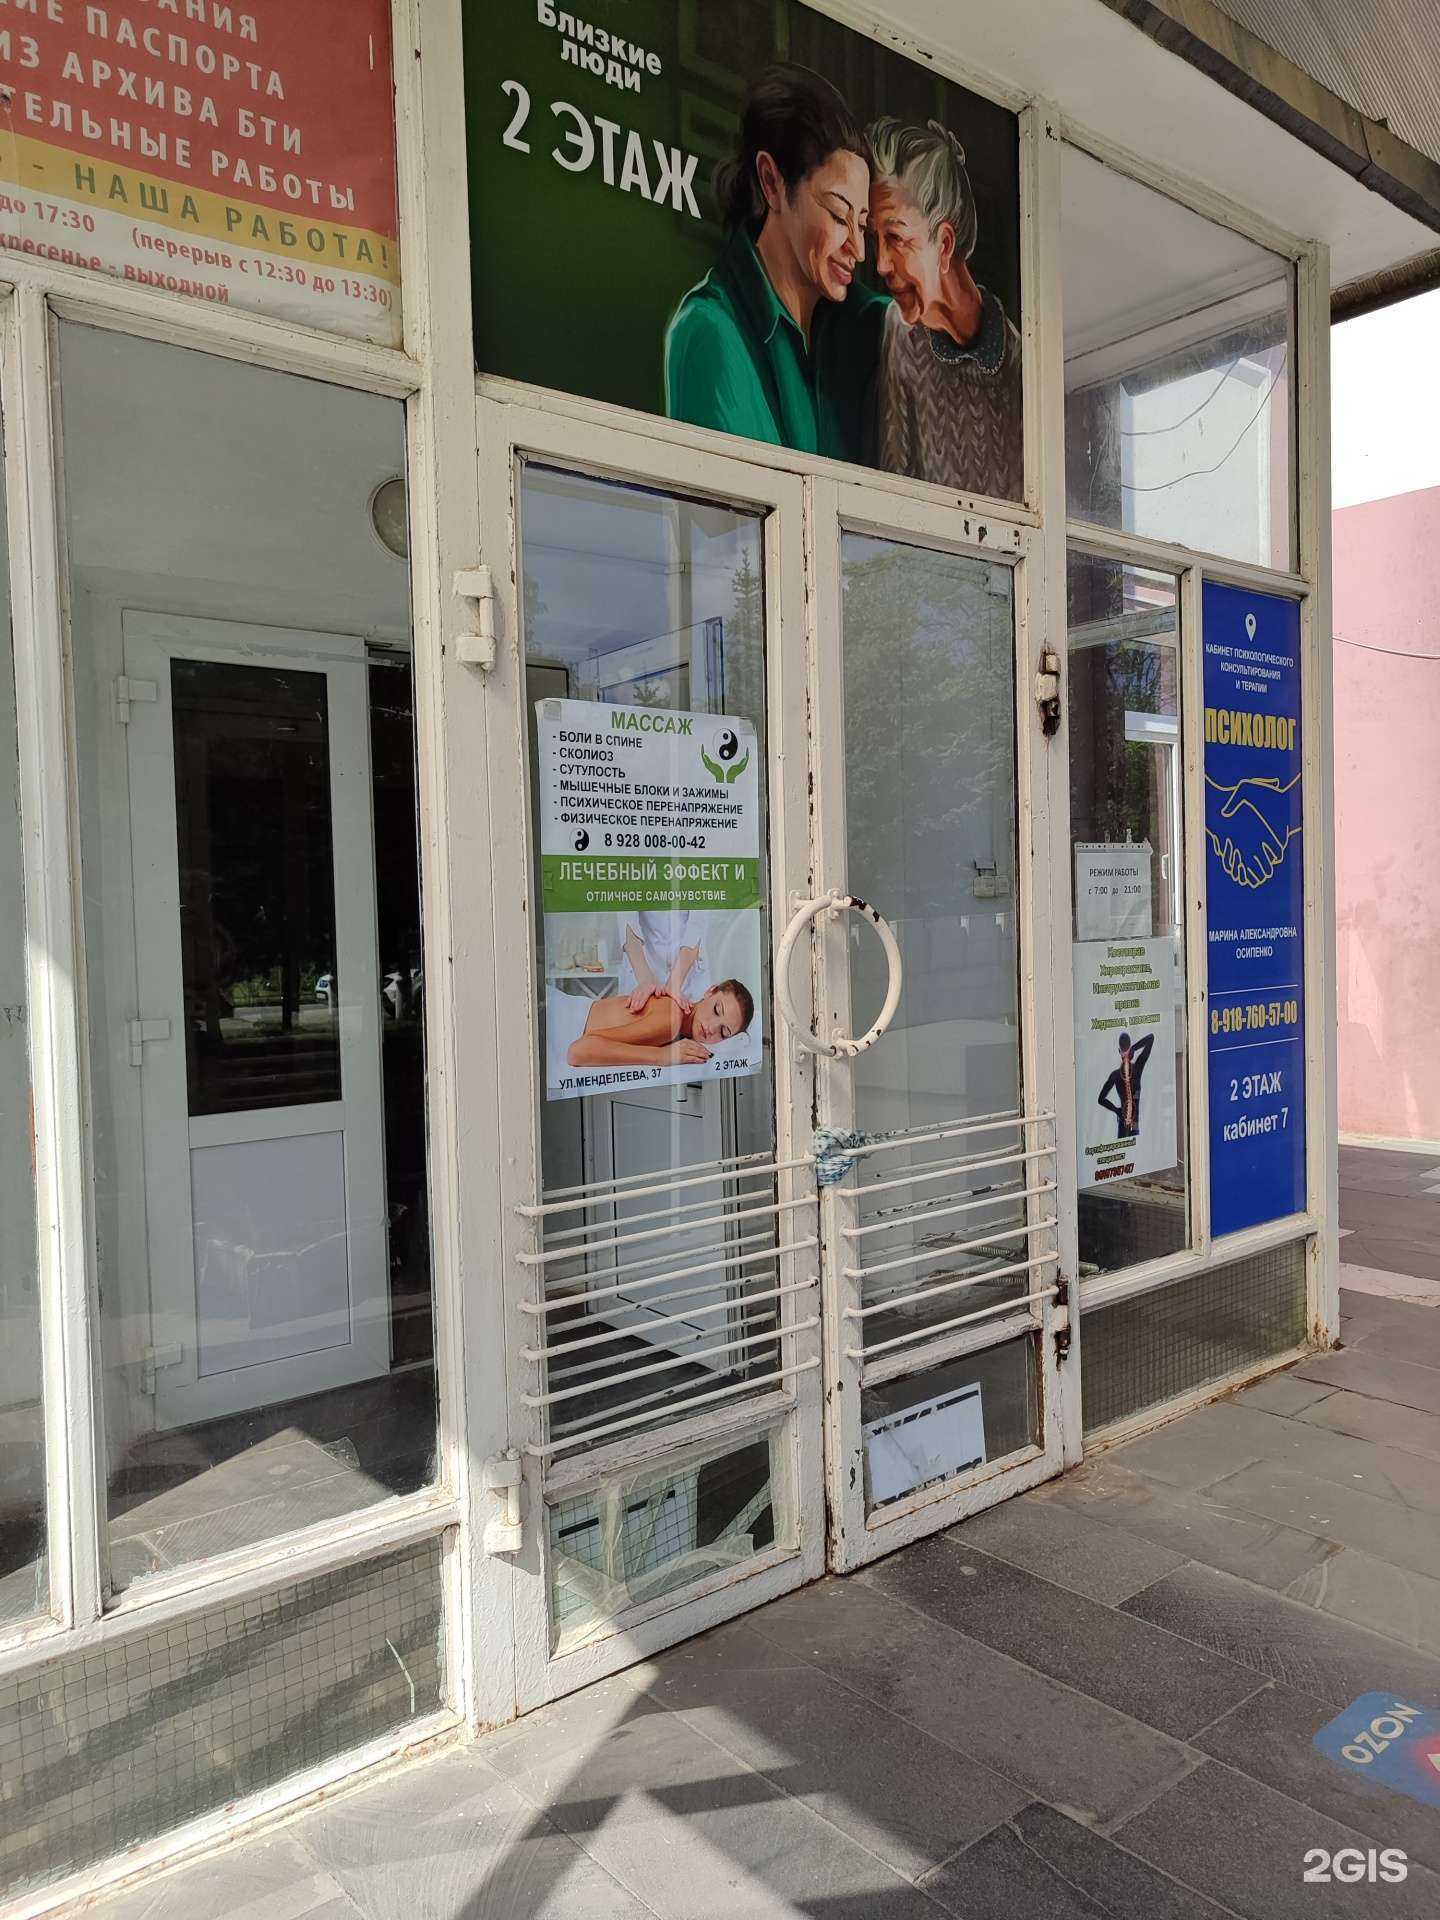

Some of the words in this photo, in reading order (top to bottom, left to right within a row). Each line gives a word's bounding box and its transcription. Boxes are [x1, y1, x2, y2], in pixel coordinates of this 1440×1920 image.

[537, 0, 662, 75] Близкие
[87, 5, 285, 100] ПАСПОРТА
[62, 51, 218, 128] АРХИВА
[238, 107, 301, 156] БТИ
[501, 79, 531, 154] 2
[550, 101, 702, 219] ЭТАЖ
[211, 150, 355, 211] РАБОТЫ
[74, 163, 200, 224] НАША
[225, 206, 389, 270] РАБОТА!
[34, 202, 95, 232] 17:30
[132, 227, 232, 269] (перерыв
[239, 259, 248, 273] с
[254, 259, 306, 285] 12:30
[312, 275, 335, 294] до
[341, 279, 392, 312] 13:30)
[124, 264, 229, 303] выходной
[1206, 643, 1233, 657] КАБИНЕТ
[1234, 648, 1294, 668] ПСИХОЛОГИЧЕСКОГО
[1220, 661, 1281, 680] КОНСУЛЬТИРОВАНИЯ
[1236, 680, 1240, 690] И
[1242, 681, 1268, 693] ТЕРАПИИ
[611, 711, 694, 735] МАССАЖ
[1204, 707, 1297, 750] ПСИХОЛОГ
[559, 731, 592, 745] БОЛИ
[595, 734, 602, 744] В
[606, 735, 643, 748] СПИНЕ
[559, 748, 614, 761] СКОЛИОЗ
[559, 764, 626, 778] СУТУЛОСТЬ
[560, 780, 631, 794] МЫШЕЧНЫЕ
[634, 784, 670, 796] БЛОКИ
[672, 786, 680, 797] И
[683, 787, 729, 799] ЗАЖИМЫ
[561, 797, 643, 810] ПСИХИЧЕСКОЕ
[646, 801, 743, 815] ПЕРЕНАПРЯЖЕНИЕ
[561, 813, 638, 826] ФИЗИЧЕСКОЕ
[640, 816, 738, 829] ПЕРЕНАПРЯЖЕНИЕ
[604, 833, 612, 847] 8
[617, 834, 640, 848] 928
[644, 834, 706, 849] 008-00-42
[559, 858, 657, 881] ЛЕЧЕБНЫЙ
[663, 863, 729, 881] ЭФФЕКТ
[735, 864, 745, 881] И
[1089, 868, 1113, 877] РЕЖИМ
[1114, 868, 1138, 877] РАБОТЫ
[586, 891, 643, 902] ОТЛИЧНОЕ
[646, 890, 726, 902] САМОЧУВСТВИЕ
[1209, 930, 1238, 942] МАРИНА
[1240, 927, 1297, 940] АЛЕКСАНДРОВНА
[1235, 946, 1273, 959] ОСИПЕНКО
[715, 1060, 721, 1071] 2
[723, 1058, 749, 1071] ЭТАЖ
[559, 1069, 649, 1090] УЛ.МЕНДЕЛЕЕВА,
[651, 1068, 662, 1079] 37
[1230, 1079, 1238, 1101] 2
[1242, 1071, 1282, 1099] ЭТАЖ
[1223, 1115, 1278, 1141] кабинет
[1281, 1106, 1289, 1128] 7
[1341, 1702, 1424, 1764] OZON
